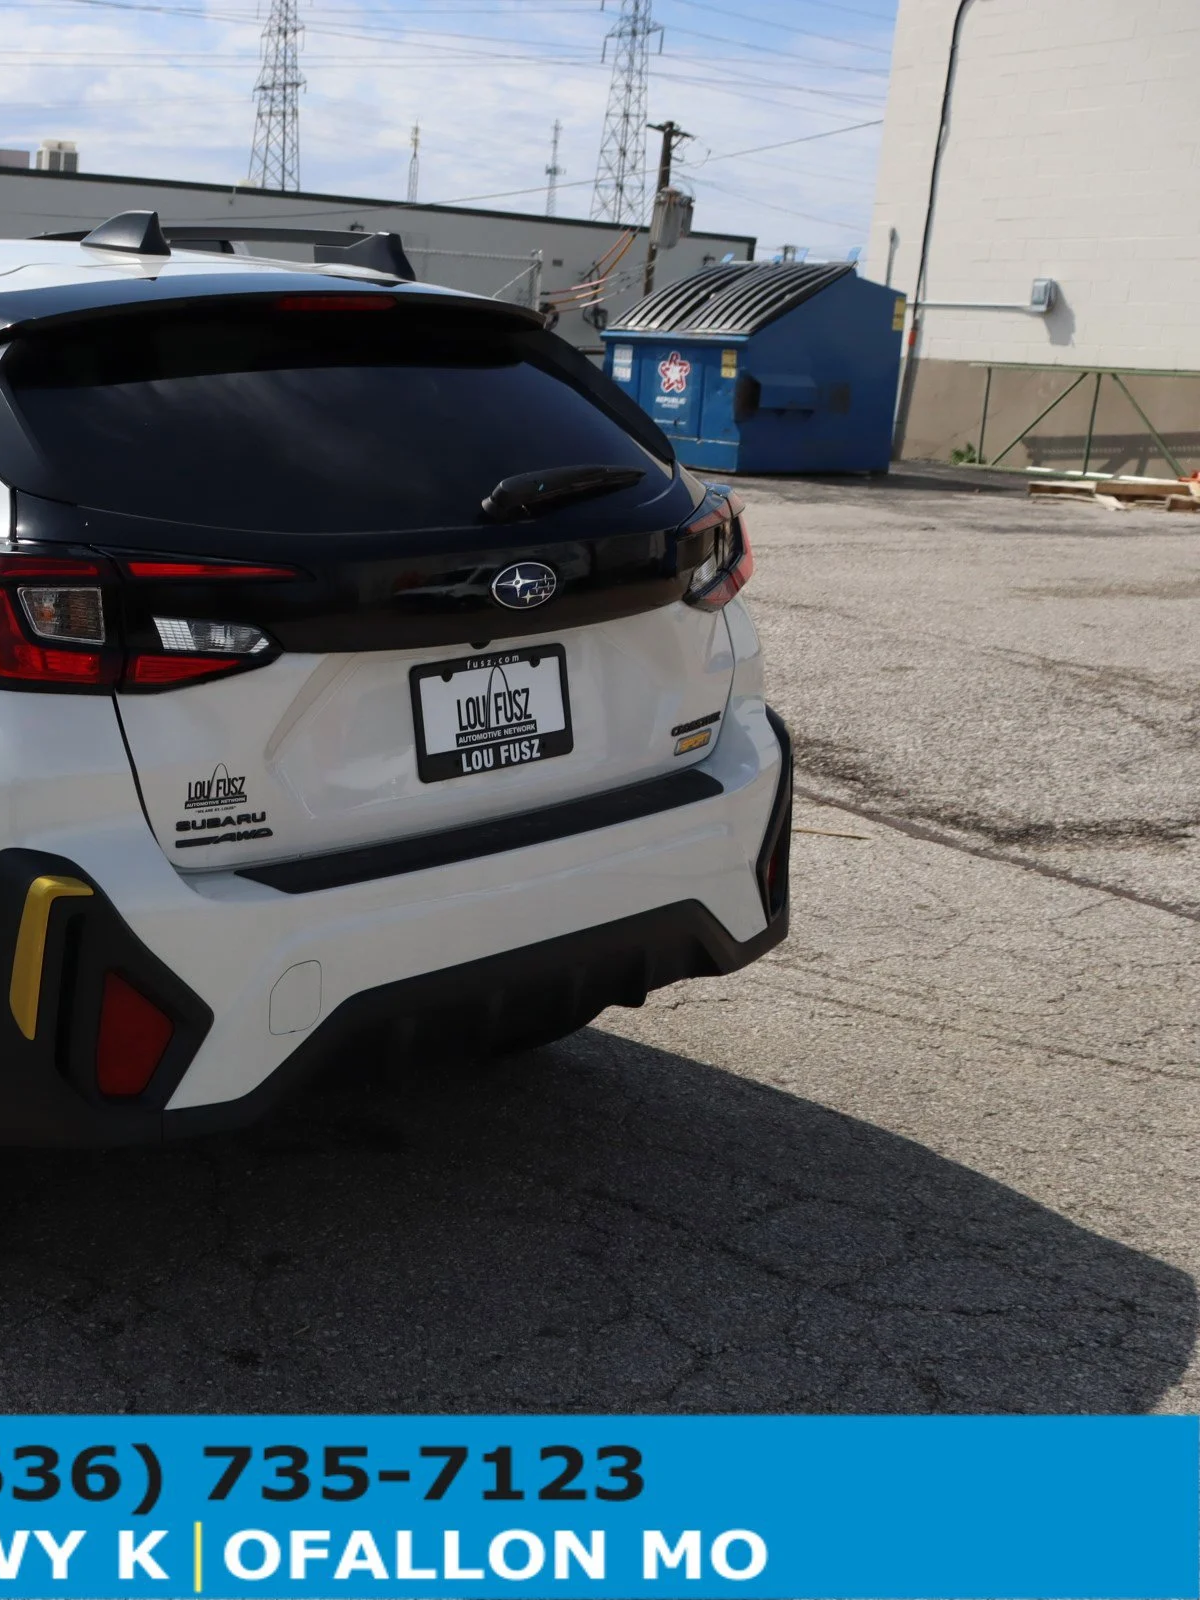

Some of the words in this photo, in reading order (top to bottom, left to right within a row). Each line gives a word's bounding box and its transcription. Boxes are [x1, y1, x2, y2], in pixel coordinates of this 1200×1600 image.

[466, 654, 520, 669] fusz.com
[456, 695, 487, 731] LOU
[494, 688, 532, 725] FUSZ
[458, 729, 502, 744] AUTOMOTIVE
[503, 723, 536, 736] NETWORK
[461, 748, 494, 773] LOU
[500, 739, 541, 765] FUSZ
[188, 780, 211, 801] LOU
[216, 776, 246, 798] FUSZ
[176, 811, 266, 831] SUBARU
[211, 827, 273, 845] AWD
